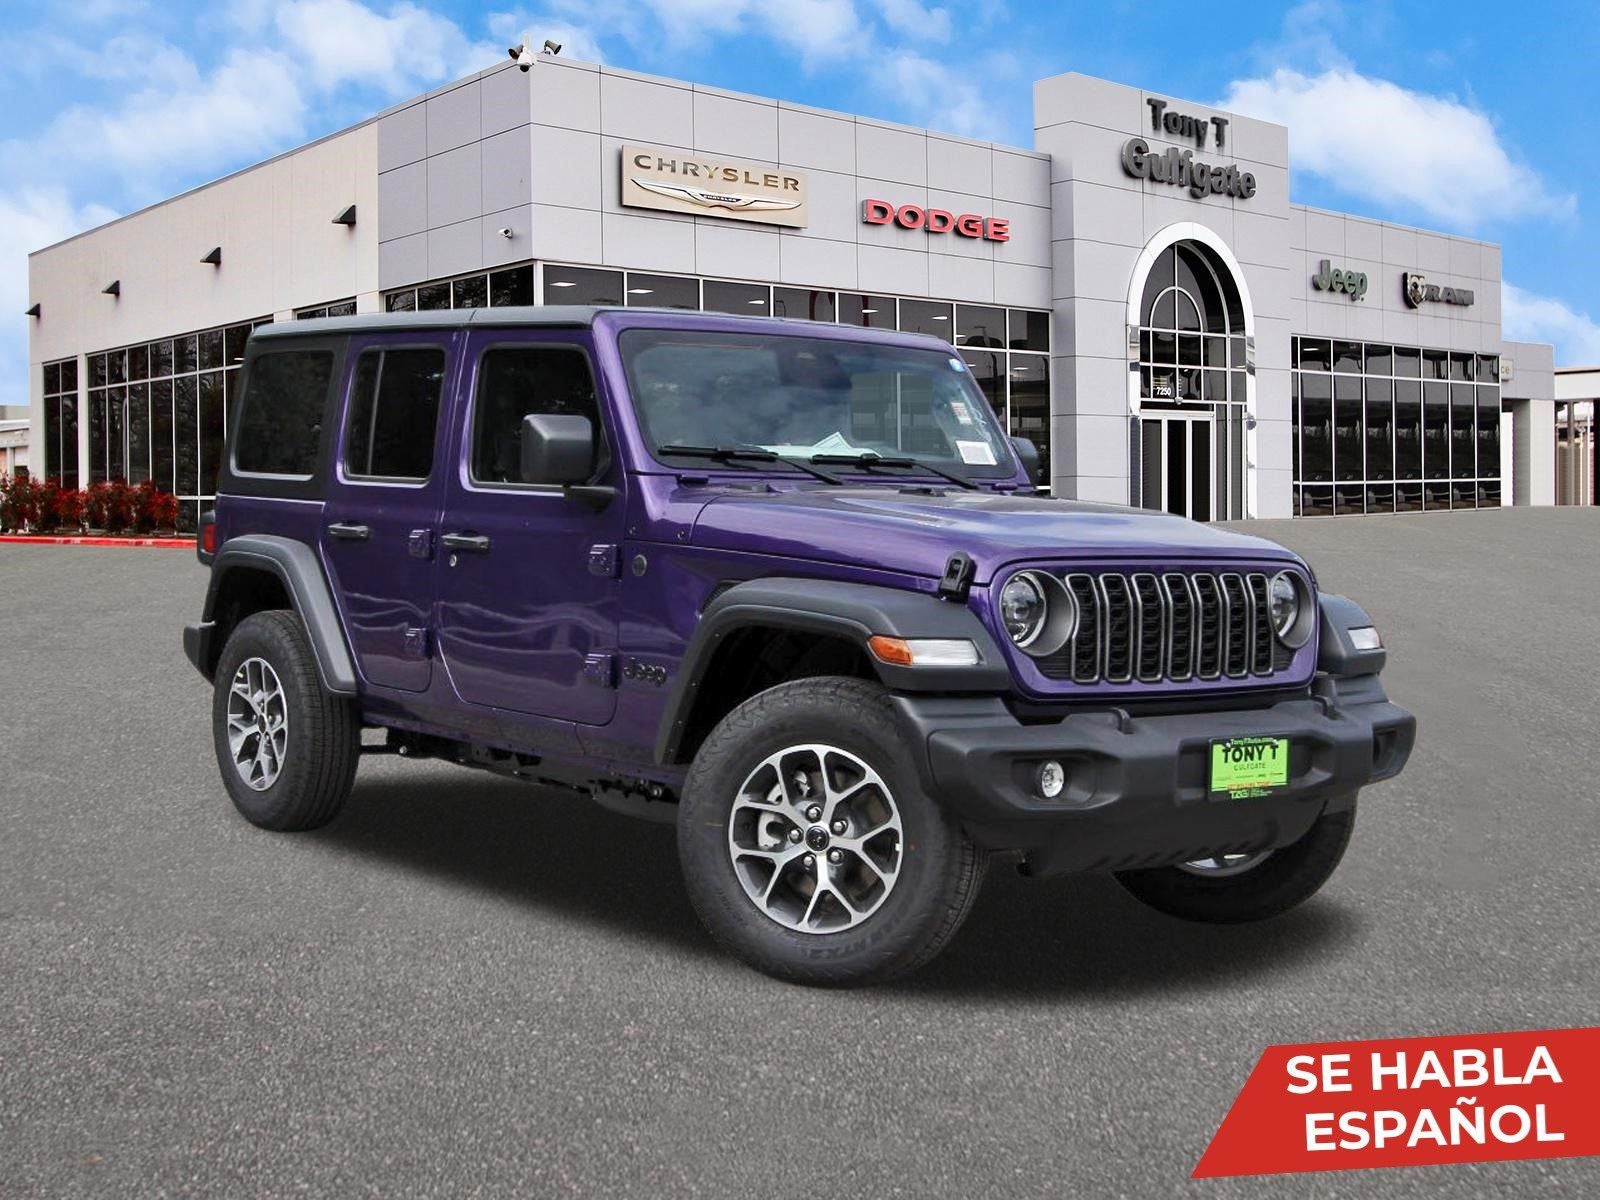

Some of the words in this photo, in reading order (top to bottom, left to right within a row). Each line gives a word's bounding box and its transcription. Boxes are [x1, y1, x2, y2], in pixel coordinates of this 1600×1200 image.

[1146, 97, 1209, 147] Tony
[1210, 116, 1229, 147] T
[633, 154, 800, 191] CHRYSLER
[1121, 137, 1256, 199] Gulfgate
[862, 198, 1010, 242] DODGE
[1312, 259, 1368, 302] Jeep
[1425, 283, 1475, 307] RAM
[1156, 386, 1172, 396] 7250
[1222, 745, 1265, 763] TONY
[1269, 744, 1279, 760] T
